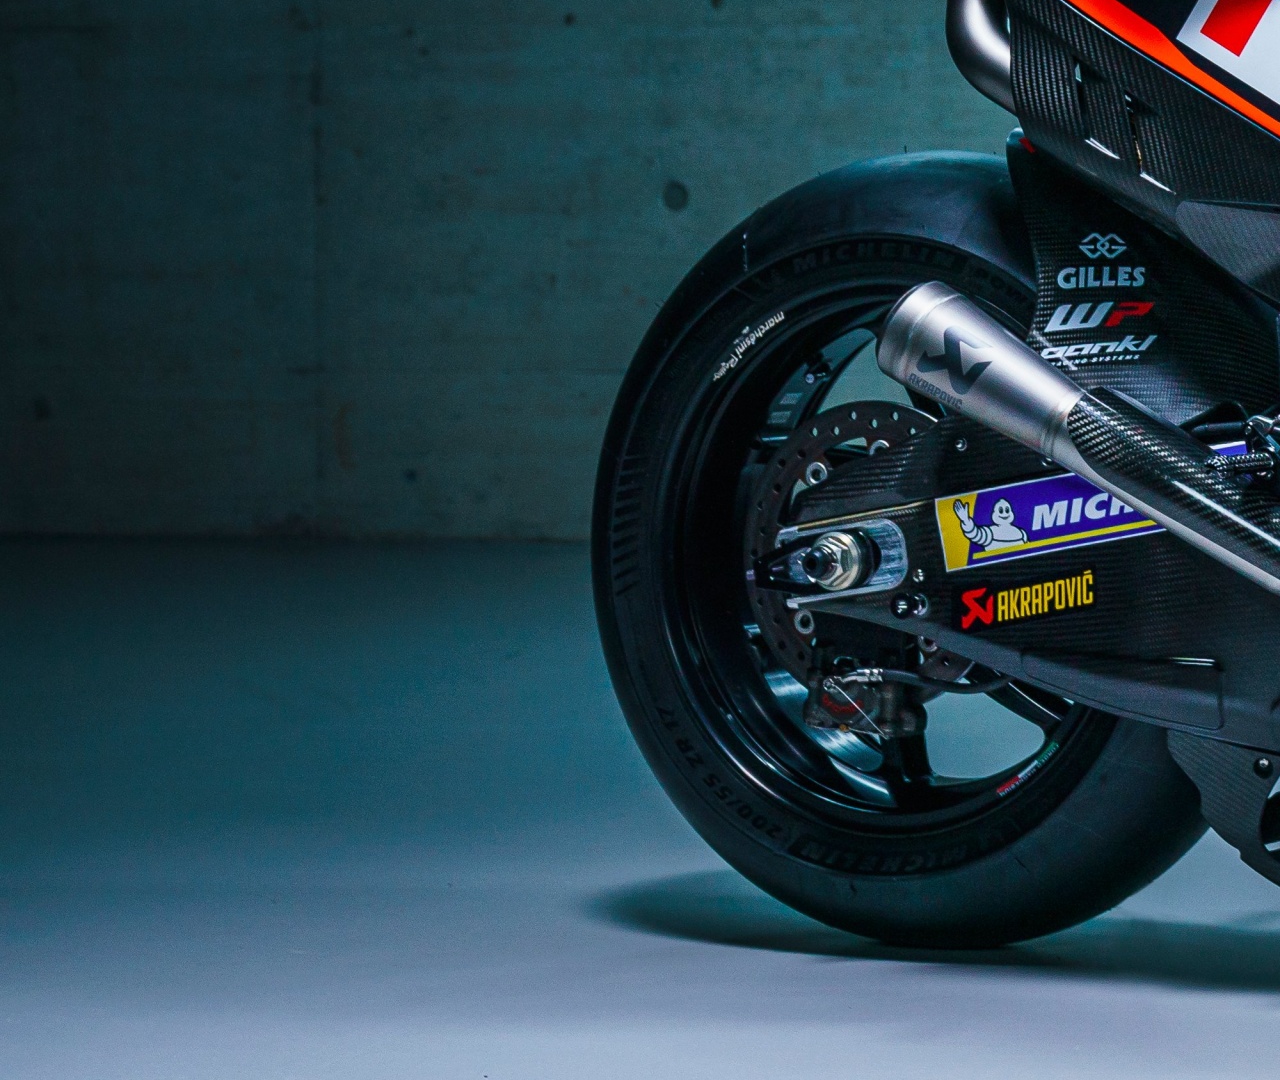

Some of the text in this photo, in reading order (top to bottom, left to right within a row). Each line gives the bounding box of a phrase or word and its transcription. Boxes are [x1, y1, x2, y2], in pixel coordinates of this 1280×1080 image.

[1057, 266, 1146, 290] GILLES
[1044, 301, 1154, 333] WP
[1091, 354, 1140, 363] SYSTEMS
[1031, 492, 1134, 532] MICH
